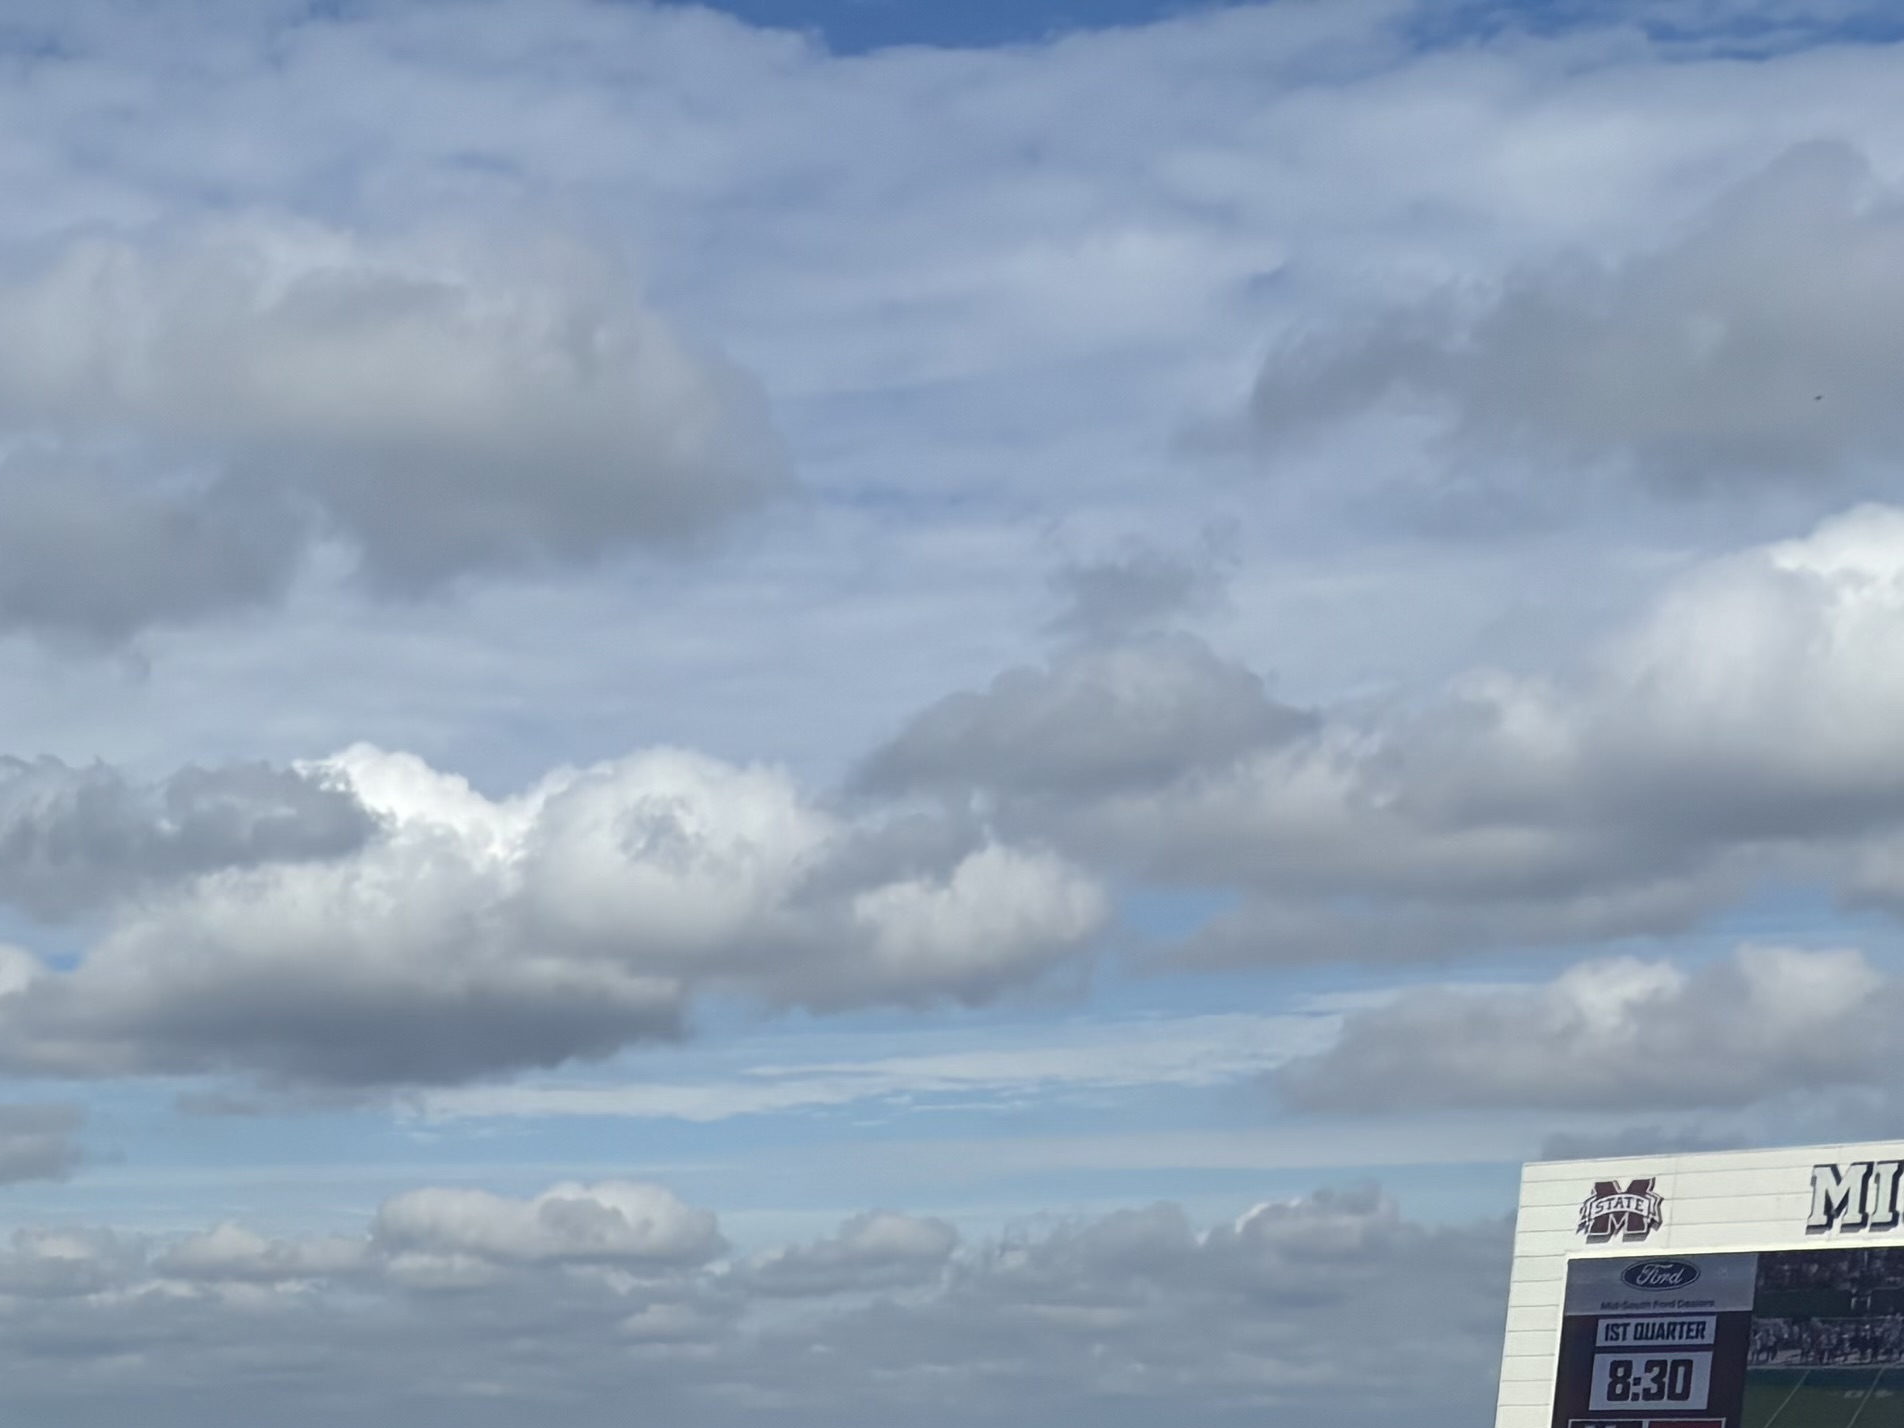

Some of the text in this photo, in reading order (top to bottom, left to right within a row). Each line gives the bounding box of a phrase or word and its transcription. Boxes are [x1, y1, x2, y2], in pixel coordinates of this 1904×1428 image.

[1595, 1196, 1645, 1215] STATE
[1636, 1263, 1685, 1285] Ford
[1603, 1320, 1707, 1343] 1ST QUARTER
[1606, 1357, 1693, 1403] 8:30
